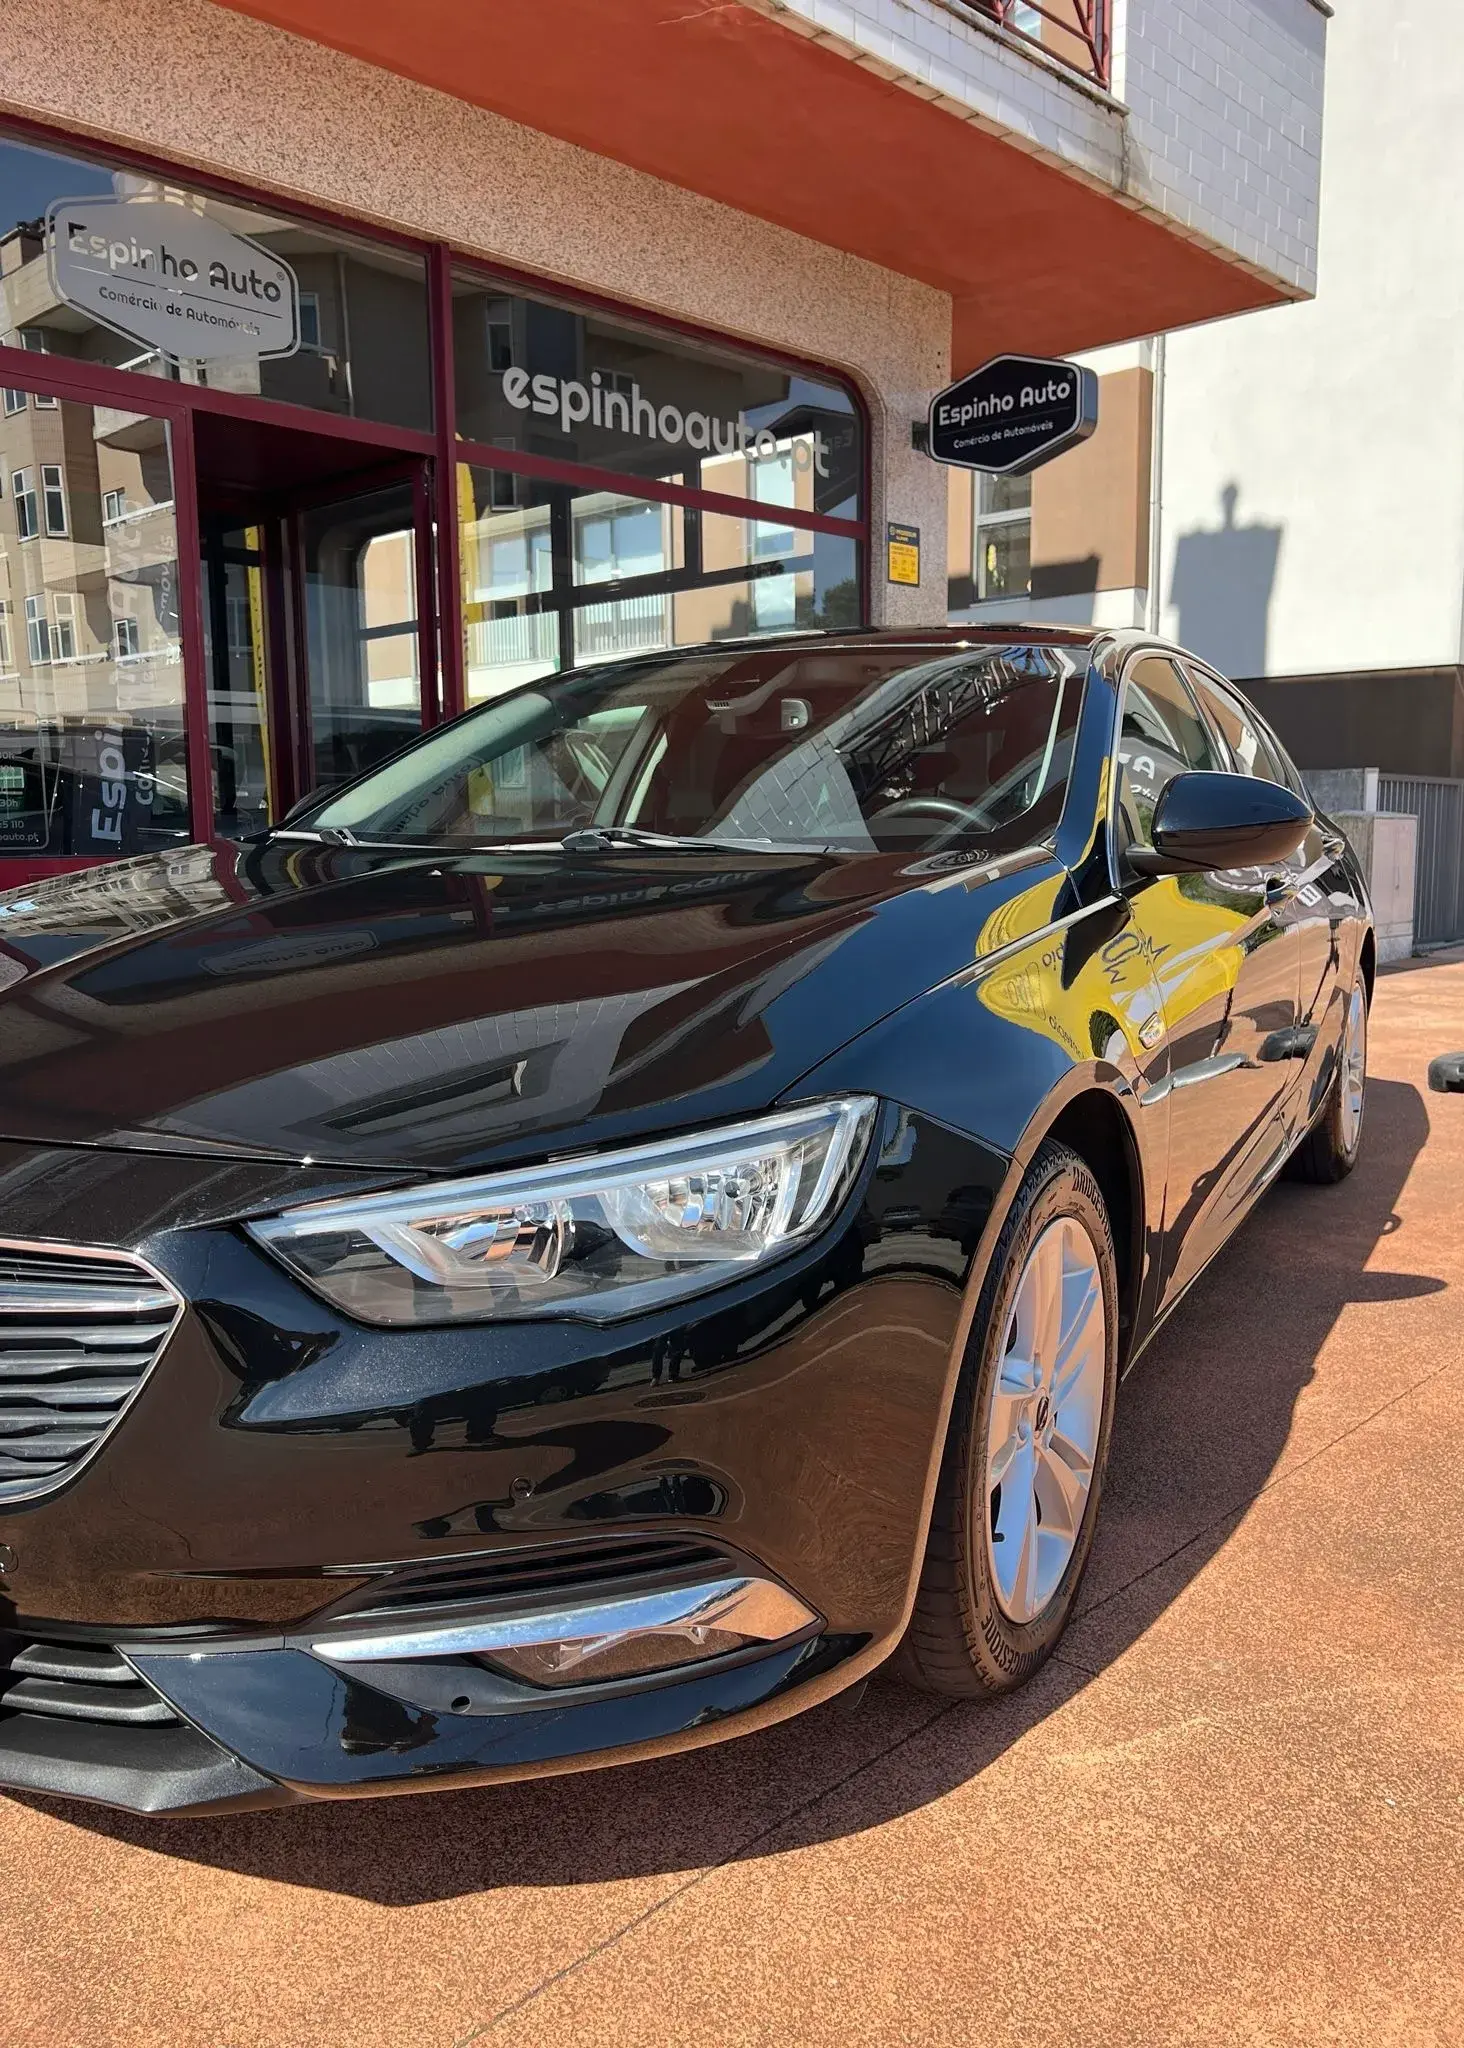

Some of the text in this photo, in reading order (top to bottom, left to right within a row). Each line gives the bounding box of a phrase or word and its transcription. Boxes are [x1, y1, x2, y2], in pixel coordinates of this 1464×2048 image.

[67, 221, 281, 303] Espinho Auto
[98, 286, 163, 311] Comércio
[165, 303, 182, 317] de
[502, 366, 830, 478] espinhoauto.pt
[938, 380, 1071, 426] Espinho Auto
[953, 420, 1053, 449] Comércio de Automóveis
